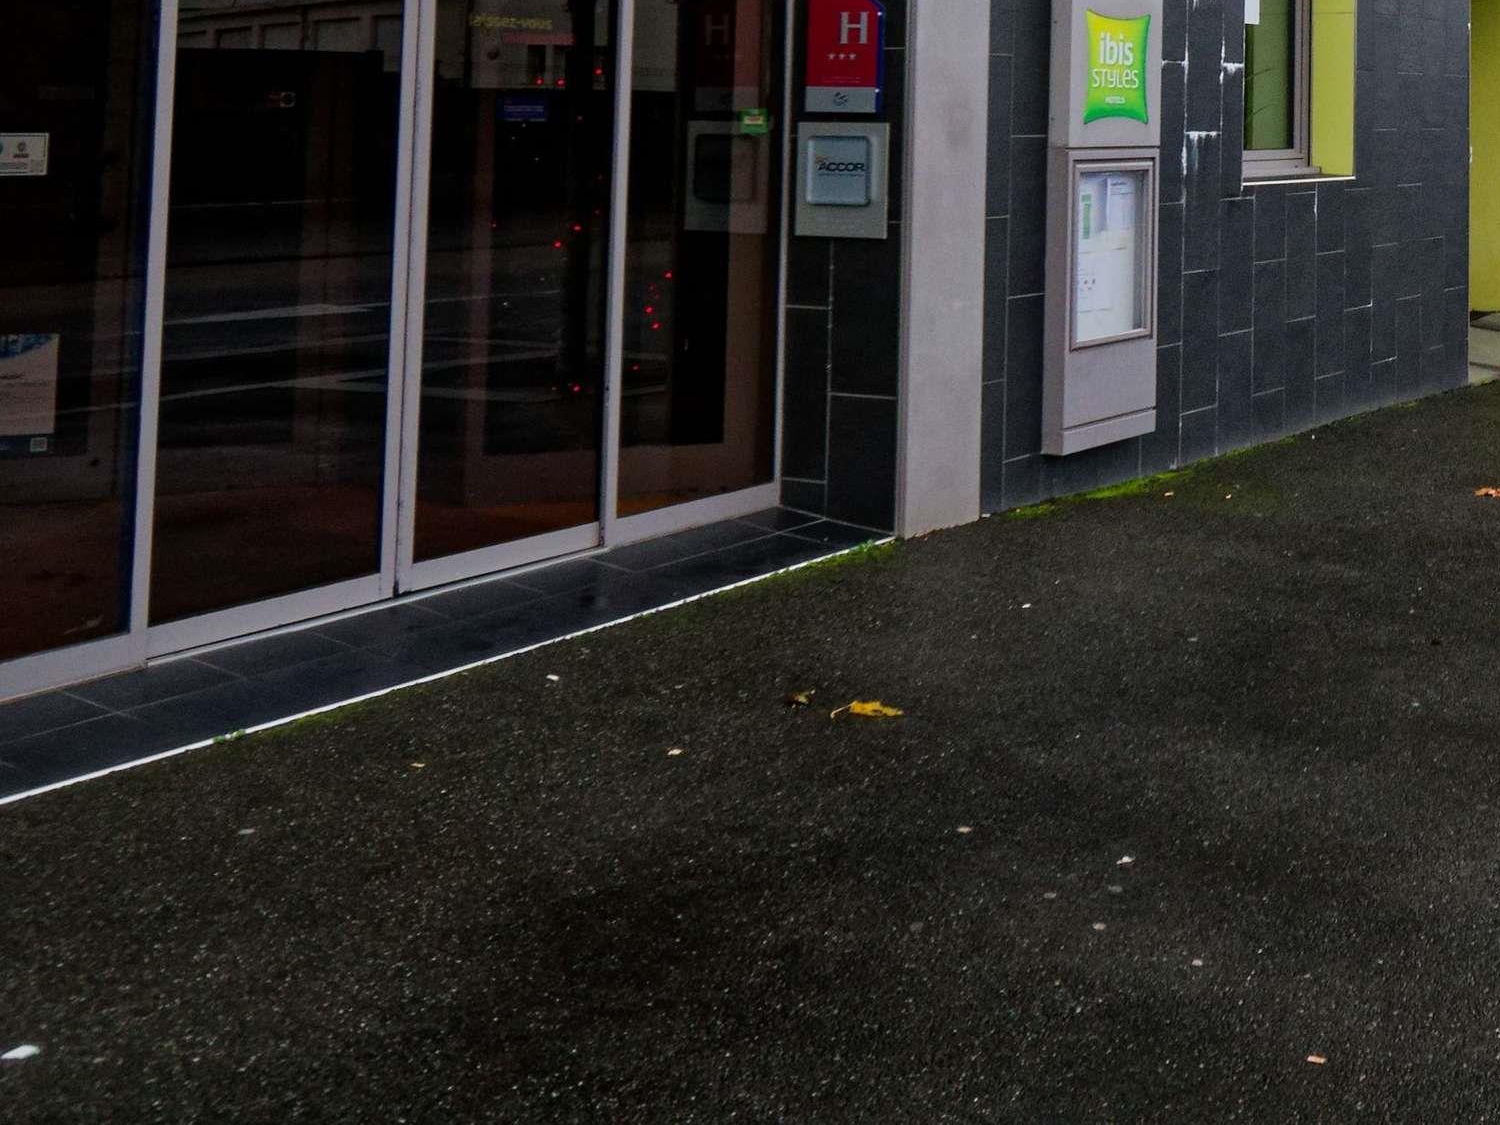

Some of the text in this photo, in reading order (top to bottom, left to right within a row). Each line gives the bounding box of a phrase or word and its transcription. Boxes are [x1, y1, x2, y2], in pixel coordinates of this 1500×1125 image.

[840, 11, 869, 44] H
[1099, 31, 1133, 66] ibis
[818, 161, 865, 172] ACCOR
